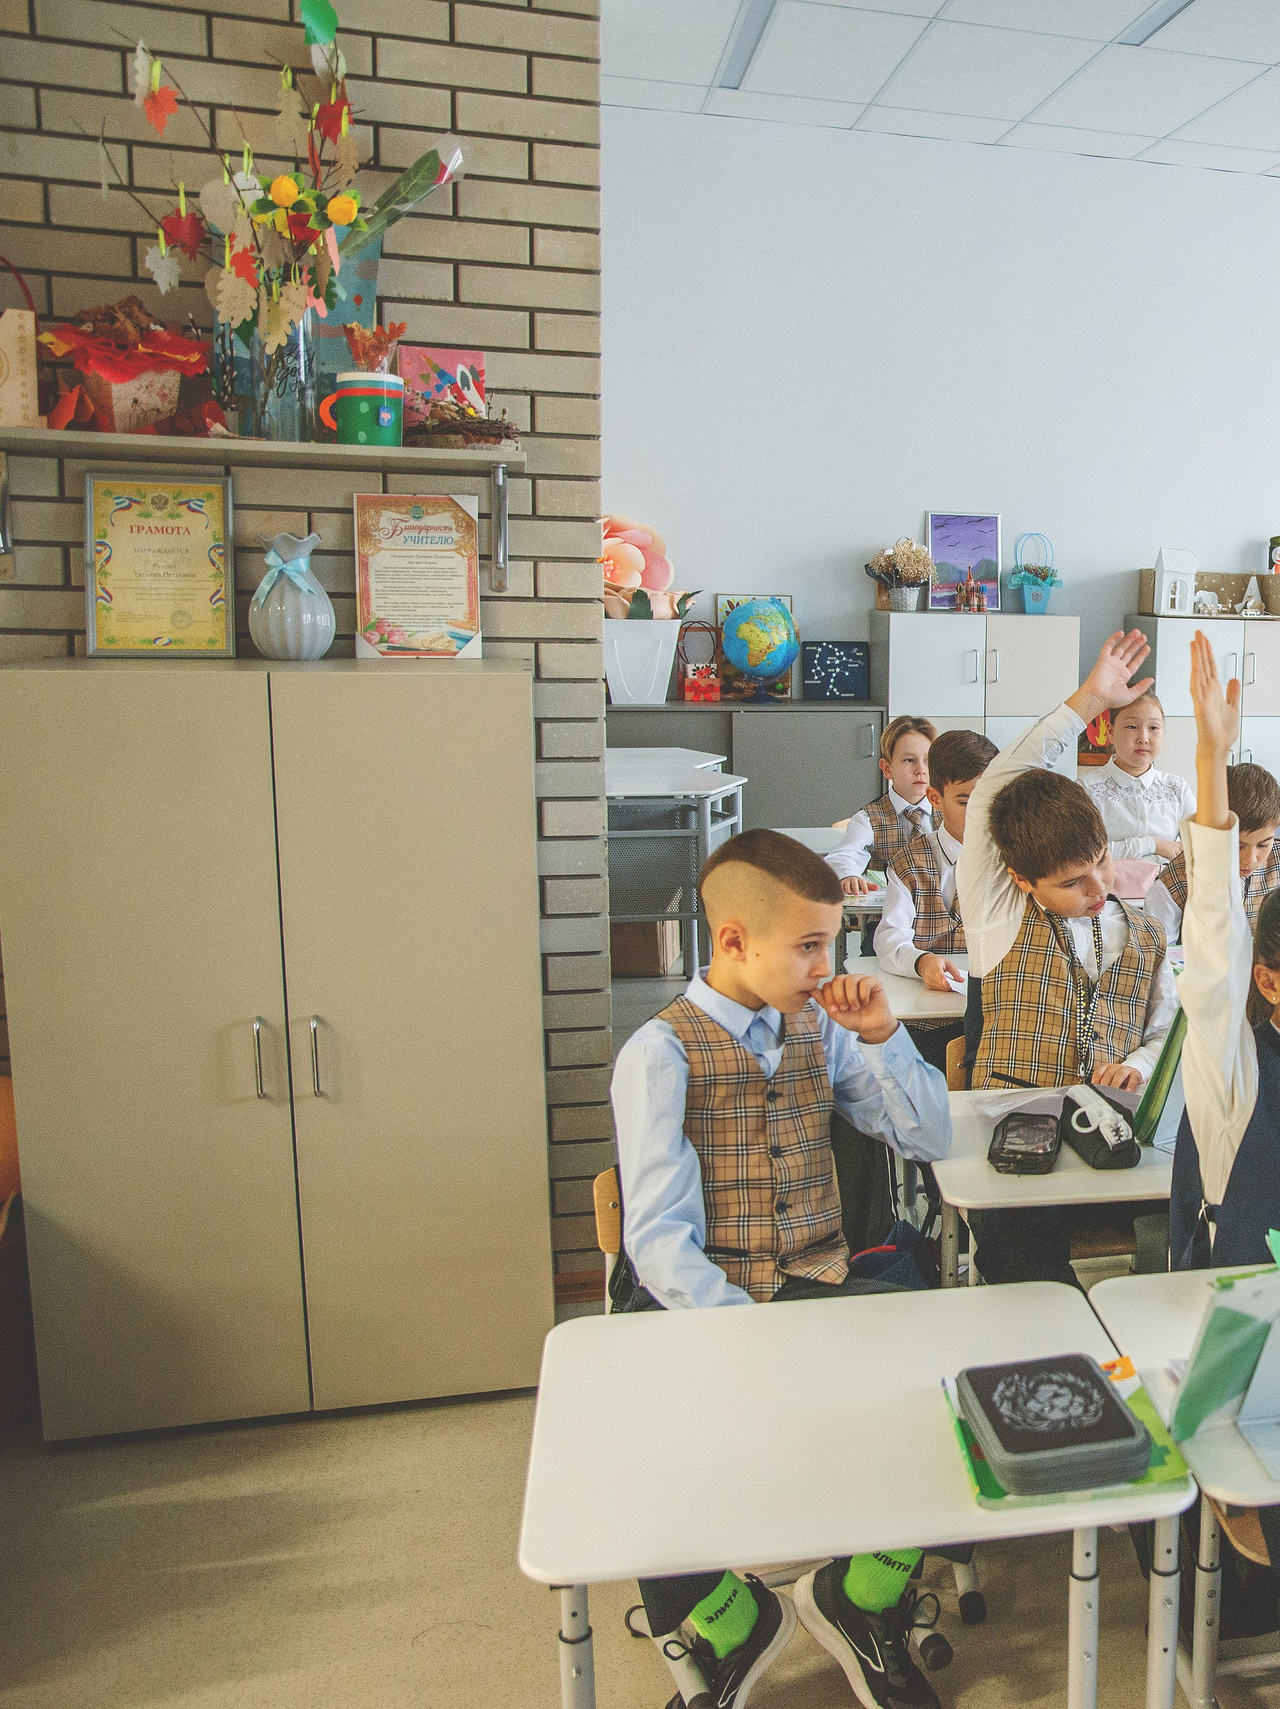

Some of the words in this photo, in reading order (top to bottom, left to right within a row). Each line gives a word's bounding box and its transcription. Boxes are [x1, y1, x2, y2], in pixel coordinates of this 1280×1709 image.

[129, 524, 191, 536] ГРАМОТА
[378, 517, 454, 539] Благодарность
[402, 535, 454, 545] УЧИТЕЛЮ
